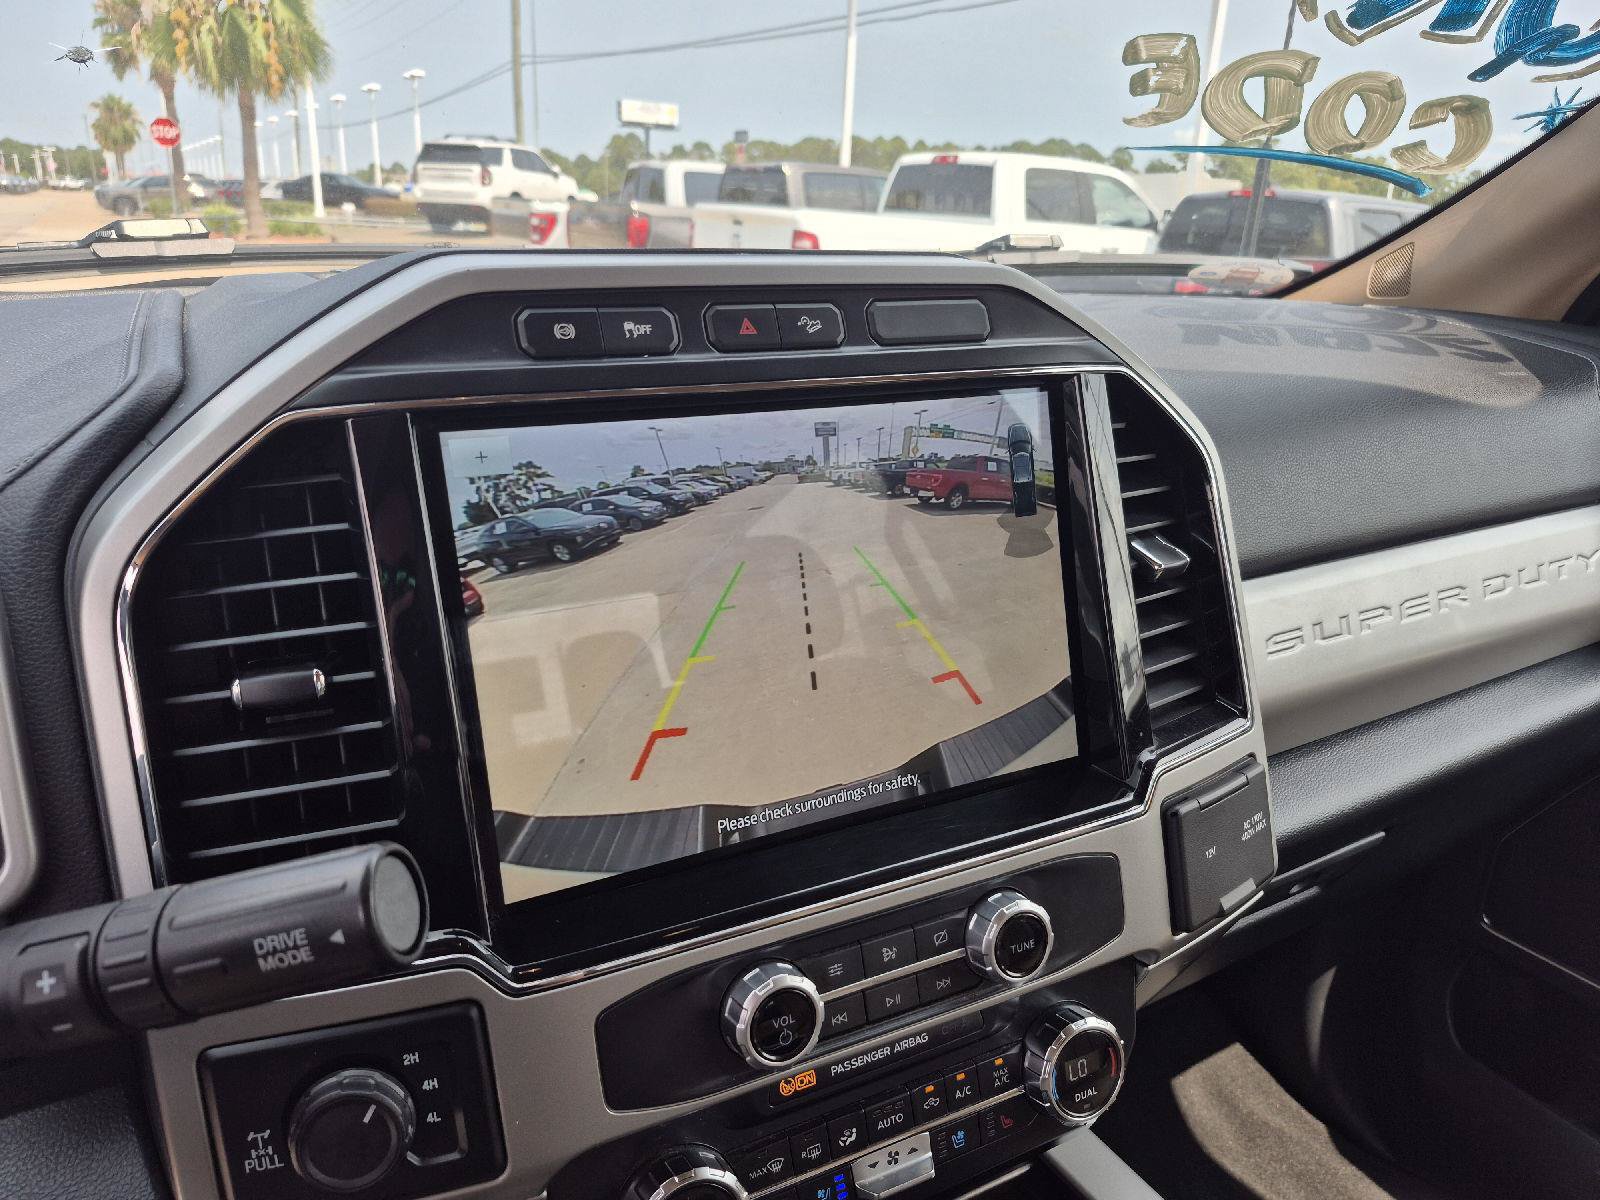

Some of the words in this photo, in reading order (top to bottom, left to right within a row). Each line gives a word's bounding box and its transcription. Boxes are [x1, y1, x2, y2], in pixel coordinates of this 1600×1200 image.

[151, 125, 179, 140] STOP
[636, 324, 652, 335] OFF
[1265, 585, 1469, 661] SUPER
[1483, 549, 1600, 601] DUTY
[717, 812, 758, 833] Please
[759, 803, 793, 822] check
[795, 787, 867, 813] surroundings
[868, 783, 884, 795] for
[885, 773, 921, 792] safety.
[253, 928, 308, 955] DRIVE
[1010, 939, 1036, 954] TUNE
[257, 946, 315, 972] MODE
[772, 1016, 796, 1028] VOL
[402, 1052, 420, 1066] 2H
[830, 1049, 891, 1077] PASSENGER
[893, 1033, 929, 1054] AIRBAG
[797, 1072, 814, 1087] ON
[993, 1066, 1009, 1078] MAX
[422, 1078, 439, 1091] 4H
[994, 1075, 1010, 1087] A/C
[955, 1085, 972, 1099] A/C
[1075, 1087, 1098, 1102] DUAL
[426, 1112, 441, 1124] 4L
[877, 1113, 905, 1130] AUTO
[801, 1151, 807, 1159] R
[244, 1154, 284, 1173] PULL
[749, 1167, 768, 1181] MAX
